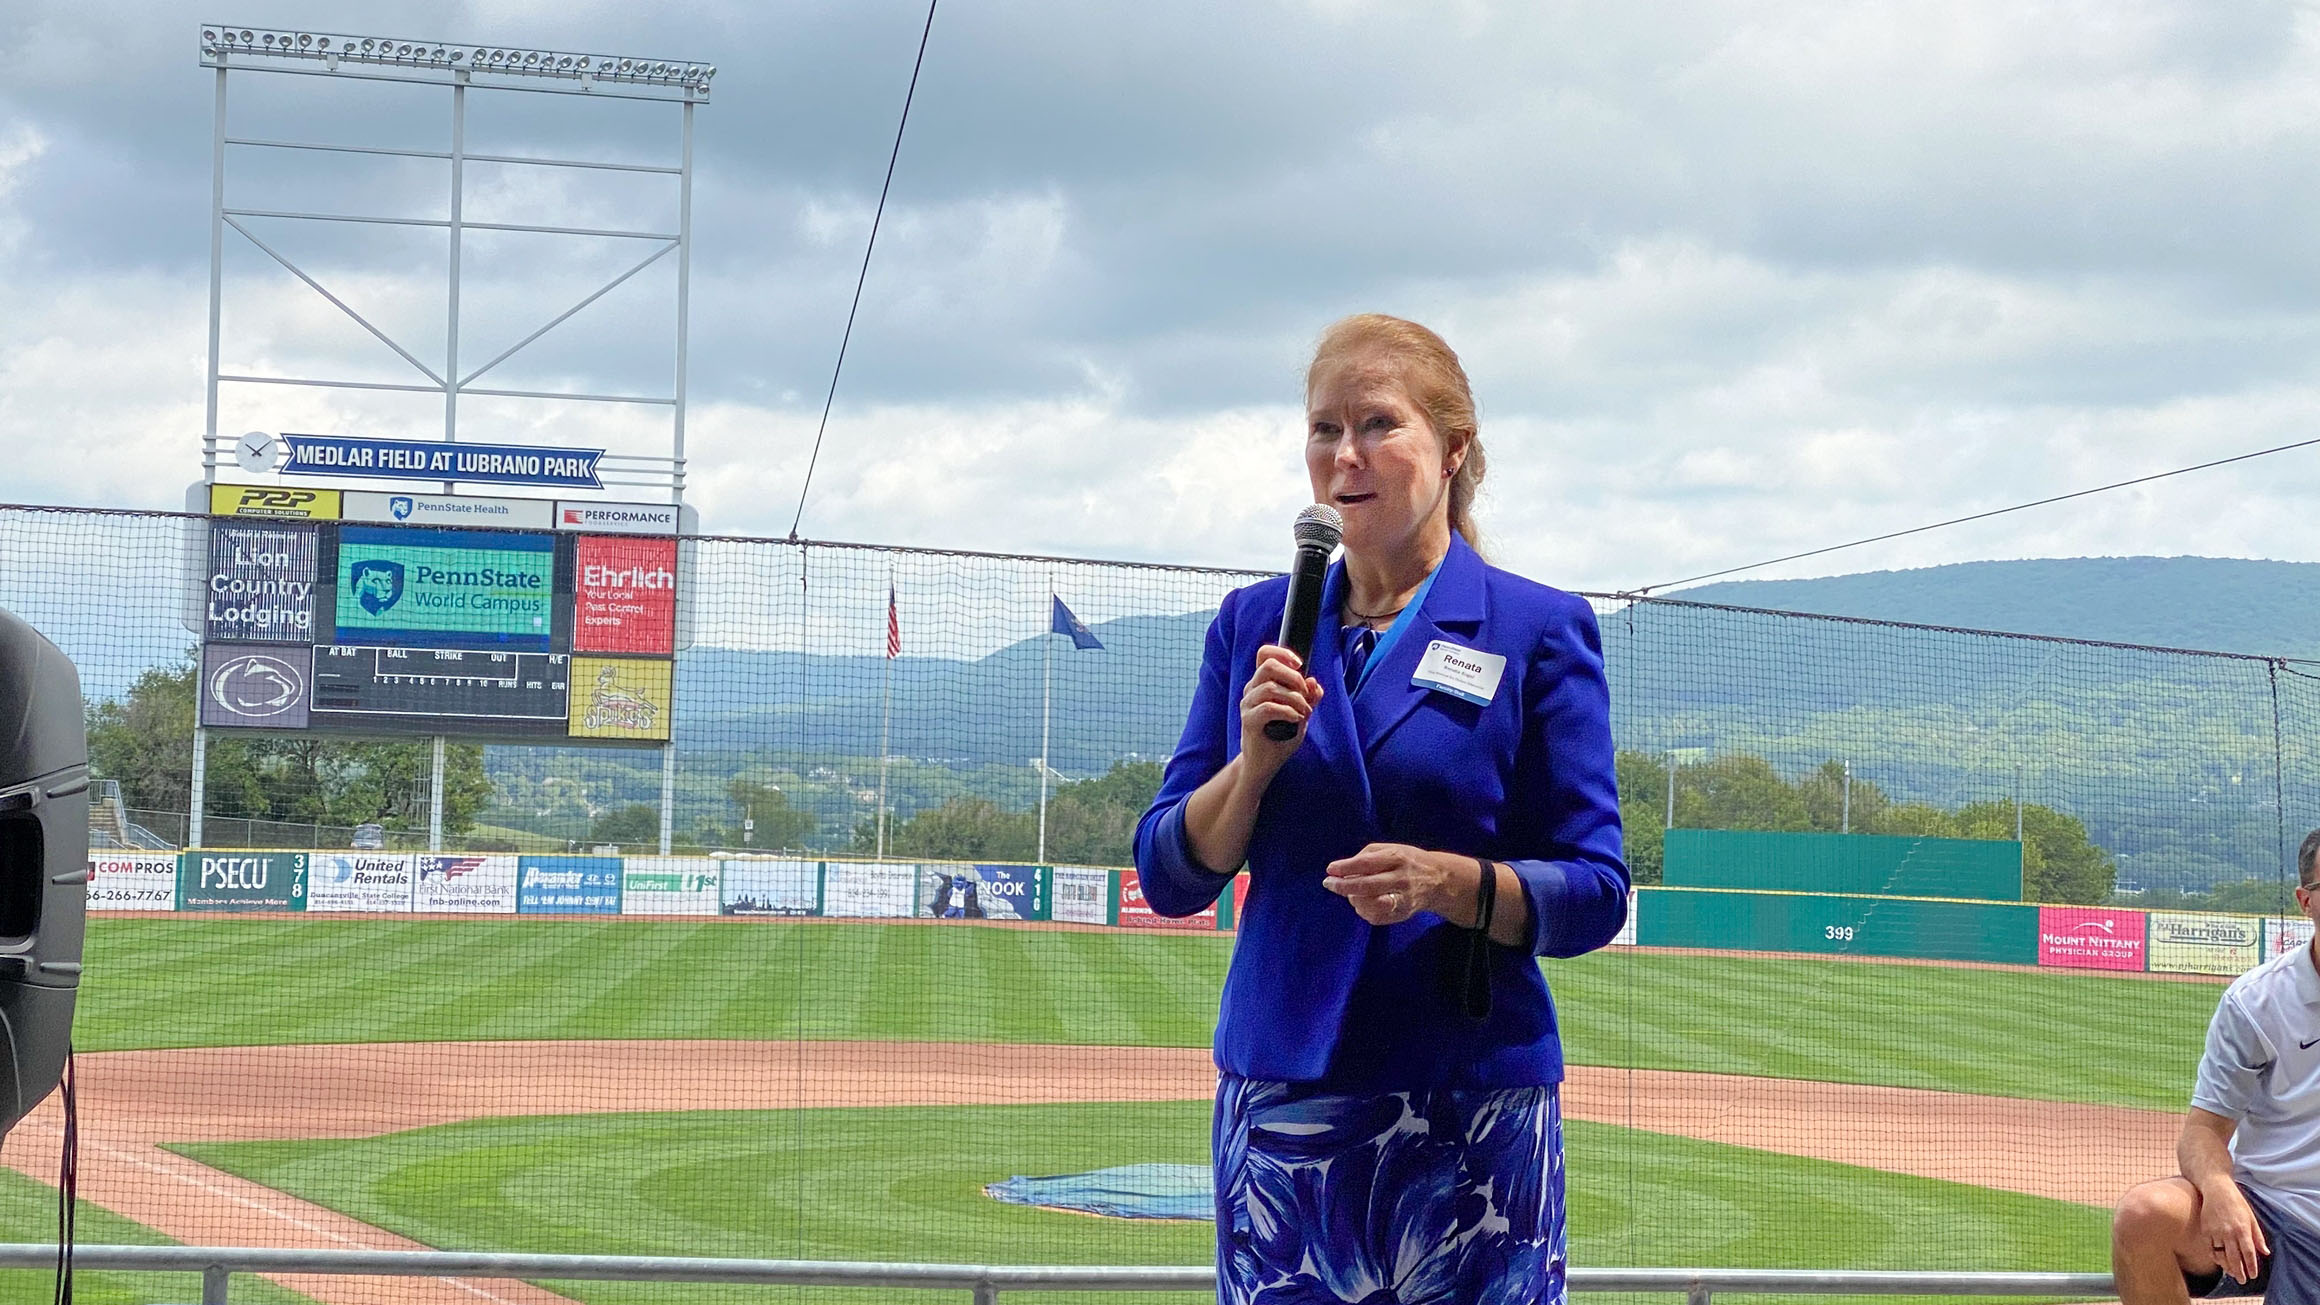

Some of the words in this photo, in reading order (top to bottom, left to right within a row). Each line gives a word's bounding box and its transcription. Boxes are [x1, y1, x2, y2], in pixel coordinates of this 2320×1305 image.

[296, 444, 373, 468] MEDLAR
[378, 448, 426, 470] FIELD
[430, 451, 453, 472] AT
[457, 452, 540, 476] LUBRANO
[543, 456, 591, 478] PARK
[240, 489, 317, 508] P2P
[417, 502, 471, 513] PennState
[474, 504, 509, 515] Health
[585, 510, 671, 524] PERFORMANCE
[235, 546, 289, 567] Lion
[416, 565, 541, 589] PennState
[584, 565, 674, 589] Ehrlich
[210, 573, 312, 601] Country
[608, 591, 634, 600] Local
[415, 592, 466, 609] World
[470, 593, 540, 614] Campus
[208, 602, 311, 630] Lodging
[585, 615, 622, 626] Experts
[329, 647, 339, 656] AT
[341, 648, 356, 657] BAT
[387, 649, 407, 659] BALL
[434, 651, 463, 661] STRIKE
[490, 653, 507, 662] OUT
[1443, 654, 1483, 674] Renata
[526, 681, 542, 689] HITS
[355, 859, 405, 872] United
[200, 857, 268, 889] PSECU
[354, 872, 408, 884] Rentals
[996, 871, 1011, 880] The
[419, 883, 438, 895] First
[440, 883, 482, 895] National
[485, 884, 510, 896] Bank
[629, 880, 668, 891] UniFirst
[980, 881, 1026, 896] NOOK
[429, 897, 500, 906] fnb-online.com
[1825, 925, 1853, 940] 399
[2170, 922, 2246, 942] Harrigan's
[2049, 946, 2099, 957] PHYSICIAN
[2101, 951, 2134, 959] GROUP
